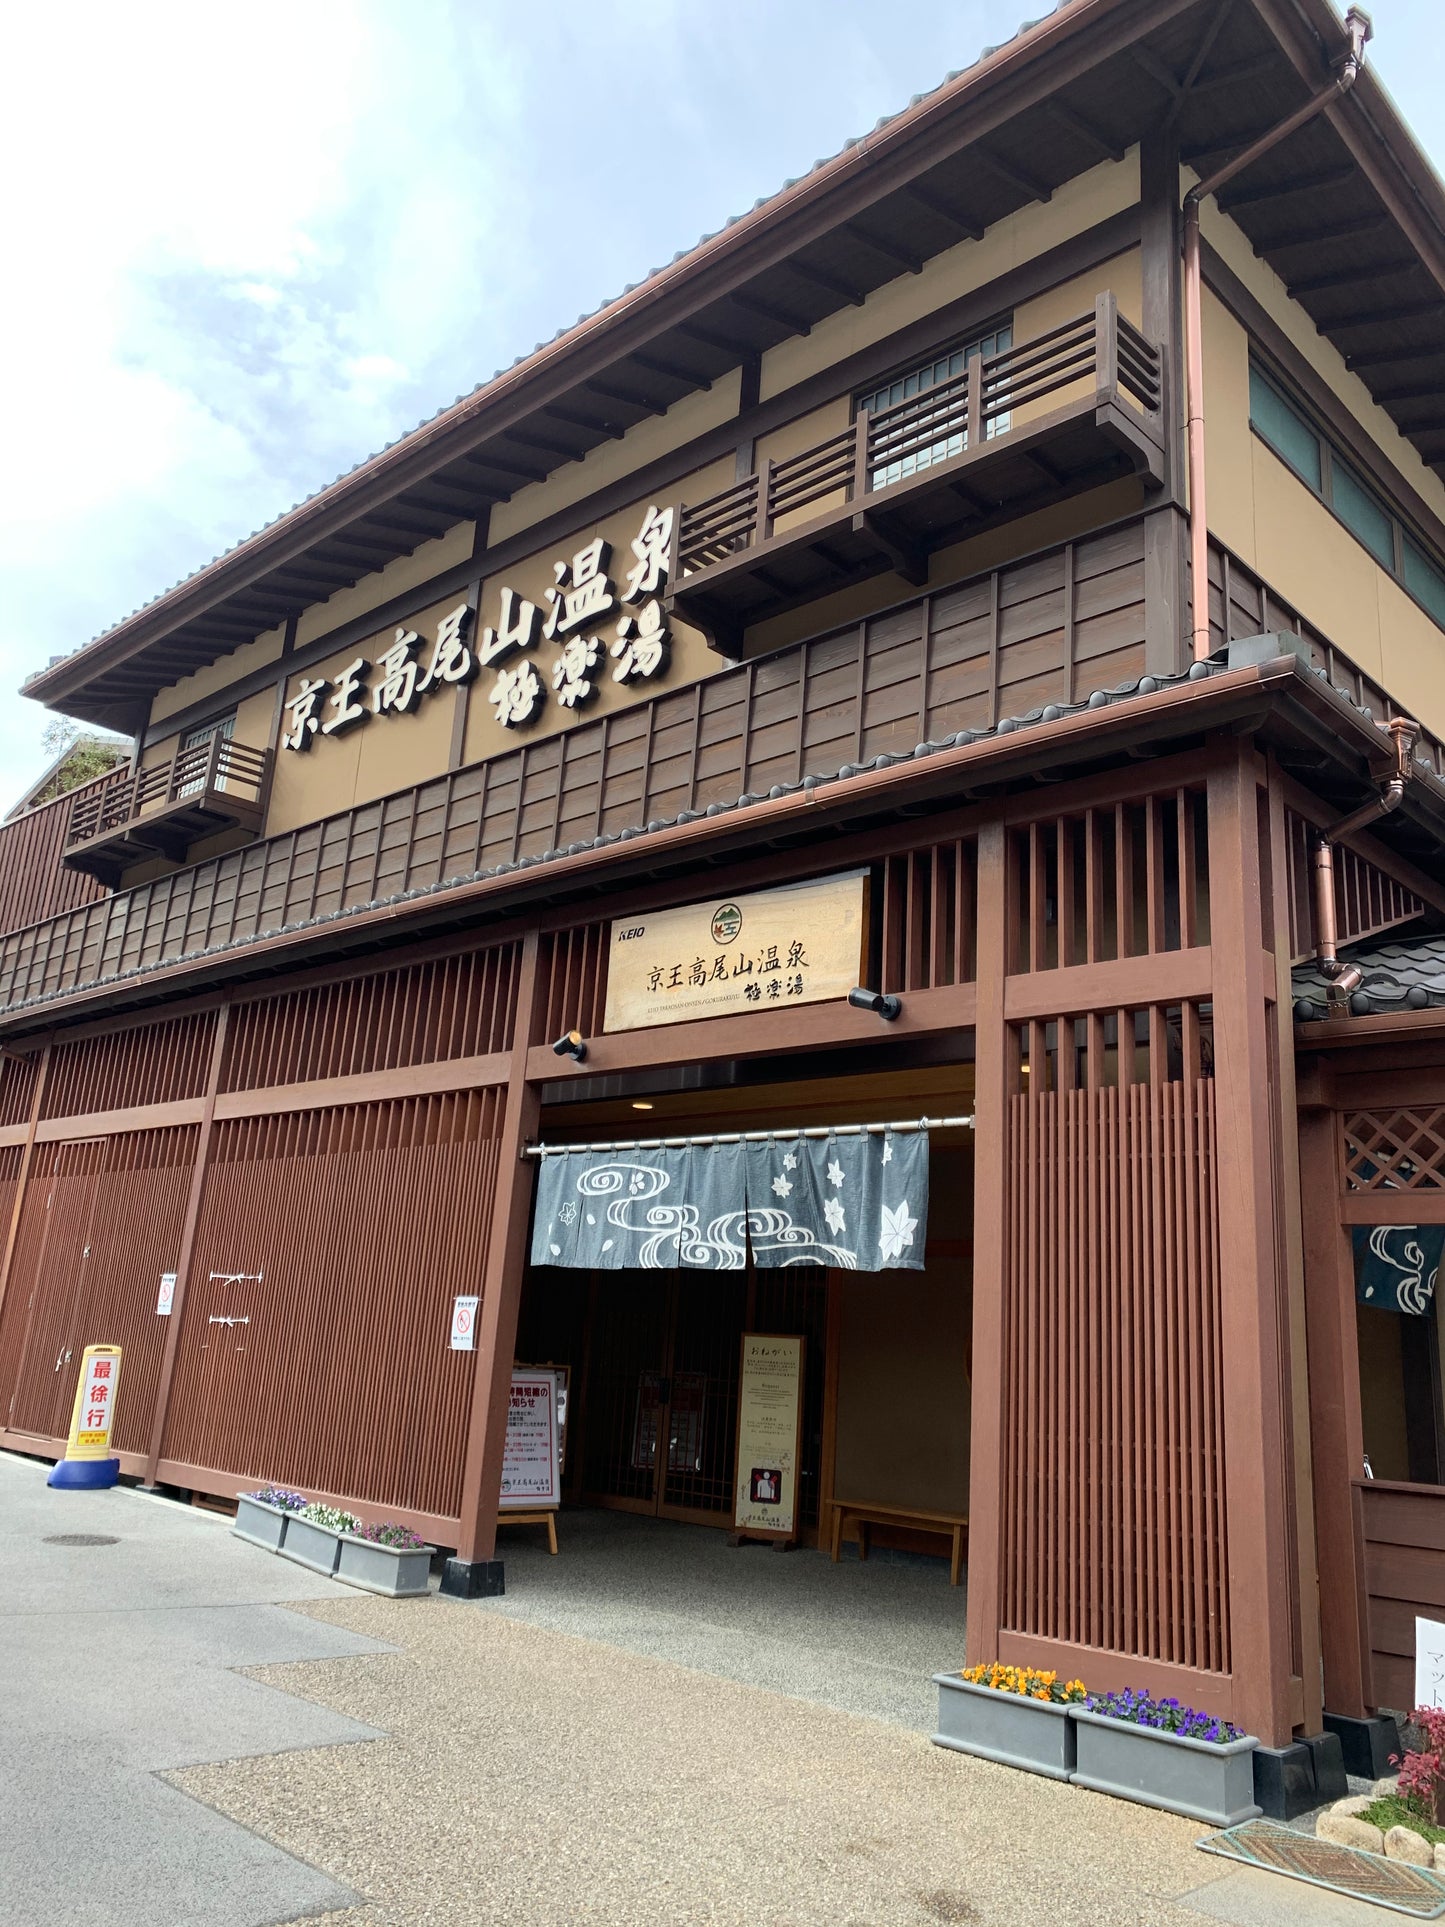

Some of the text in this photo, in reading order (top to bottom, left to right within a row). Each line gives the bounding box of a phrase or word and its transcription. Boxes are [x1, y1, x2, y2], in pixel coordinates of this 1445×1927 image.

[282, 505, 674, 750] 京王高尾山温泉
[489, 599, 669, 728] 極楽湯
[618, 926, 645, 942] KEIO
[647, 940, 810, 992] 京王高尾山温泉
[743, 973, 804, 1001] 極楽湯
[751, 1346, 793, 1357] おねがい
[87, 1361, 111, 1427] 最徐行
